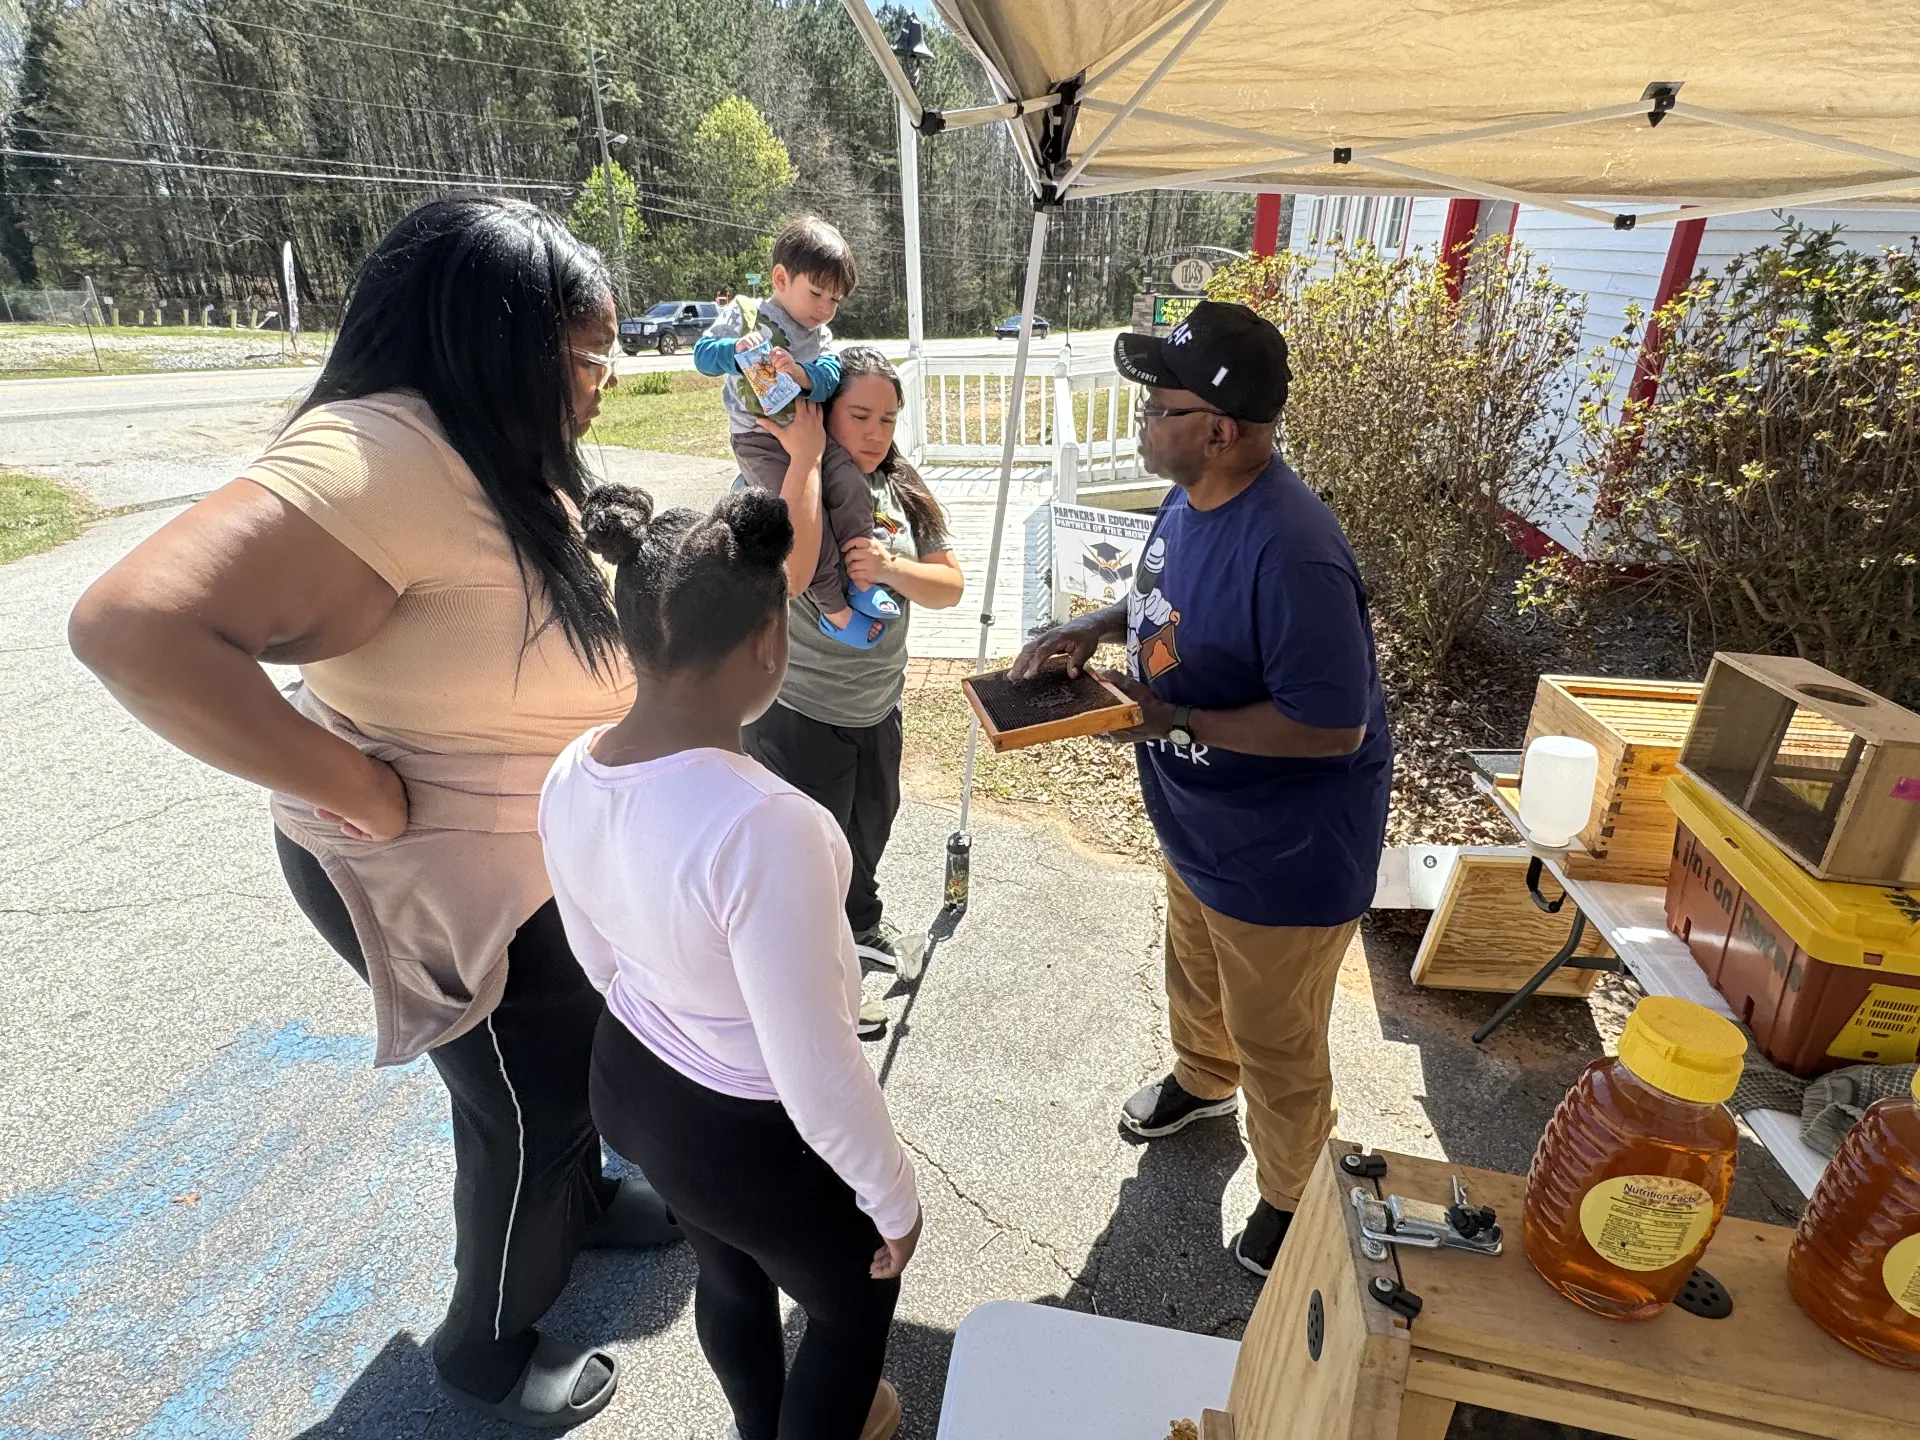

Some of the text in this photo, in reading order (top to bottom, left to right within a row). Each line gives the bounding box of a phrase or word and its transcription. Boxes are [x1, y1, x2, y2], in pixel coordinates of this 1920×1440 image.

[1126, 364, 1138, 376] AIR
[1136, 371, 1158, 384] FORCE
[1053, 506, 1095, 522] PARTNERS
[1097, 513, 1106, 524] IN
[1056, 518, 1149, 541] PARTNER OF THE MONT
[1623, 1183, 1670, 1202] Nutrition
[1671, 1194, 1697, 1204] Facts
